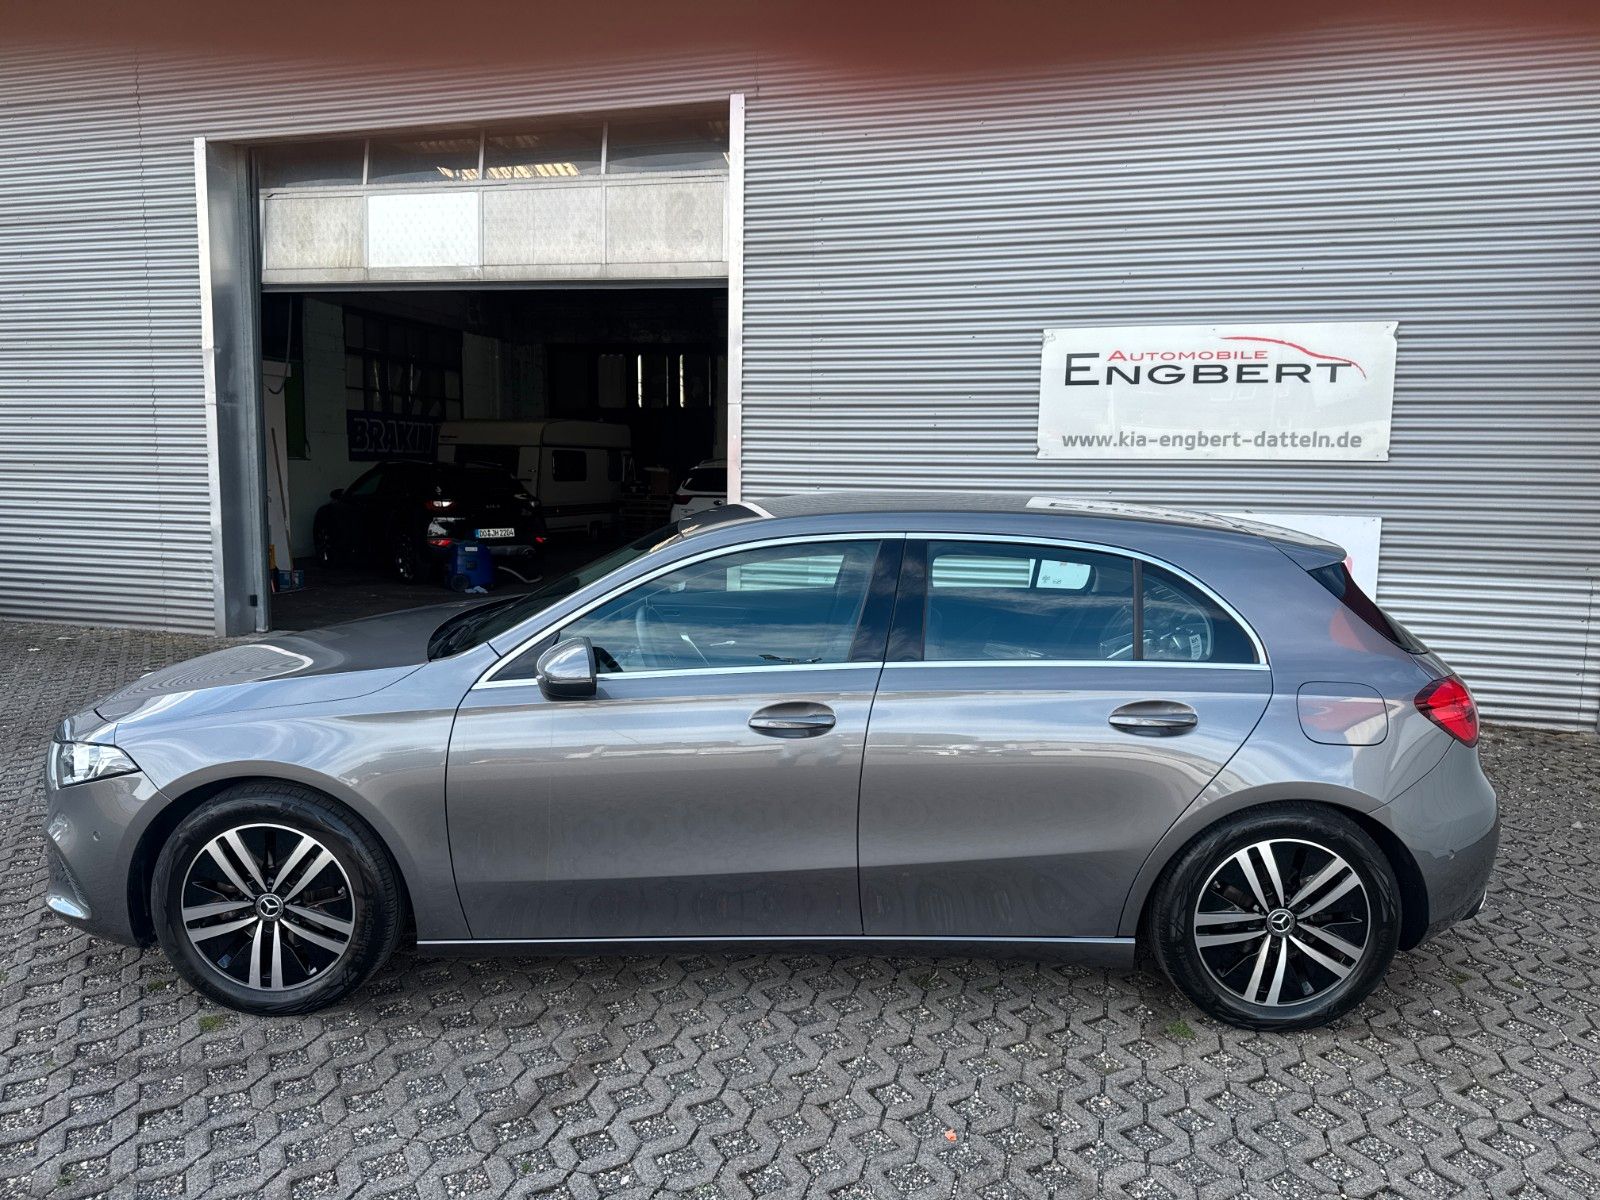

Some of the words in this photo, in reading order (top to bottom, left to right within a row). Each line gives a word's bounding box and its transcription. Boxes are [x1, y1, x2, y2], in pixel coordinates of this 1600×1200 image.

[1107, 350, 1268, 362] AUTOMOBILE
[1064, 353, 1352, 385] ENGBERT
[351, 418, 440, 453] BRAKIN
[1062, 430, 1362, 449] www.kia-engbert-datteln.de
